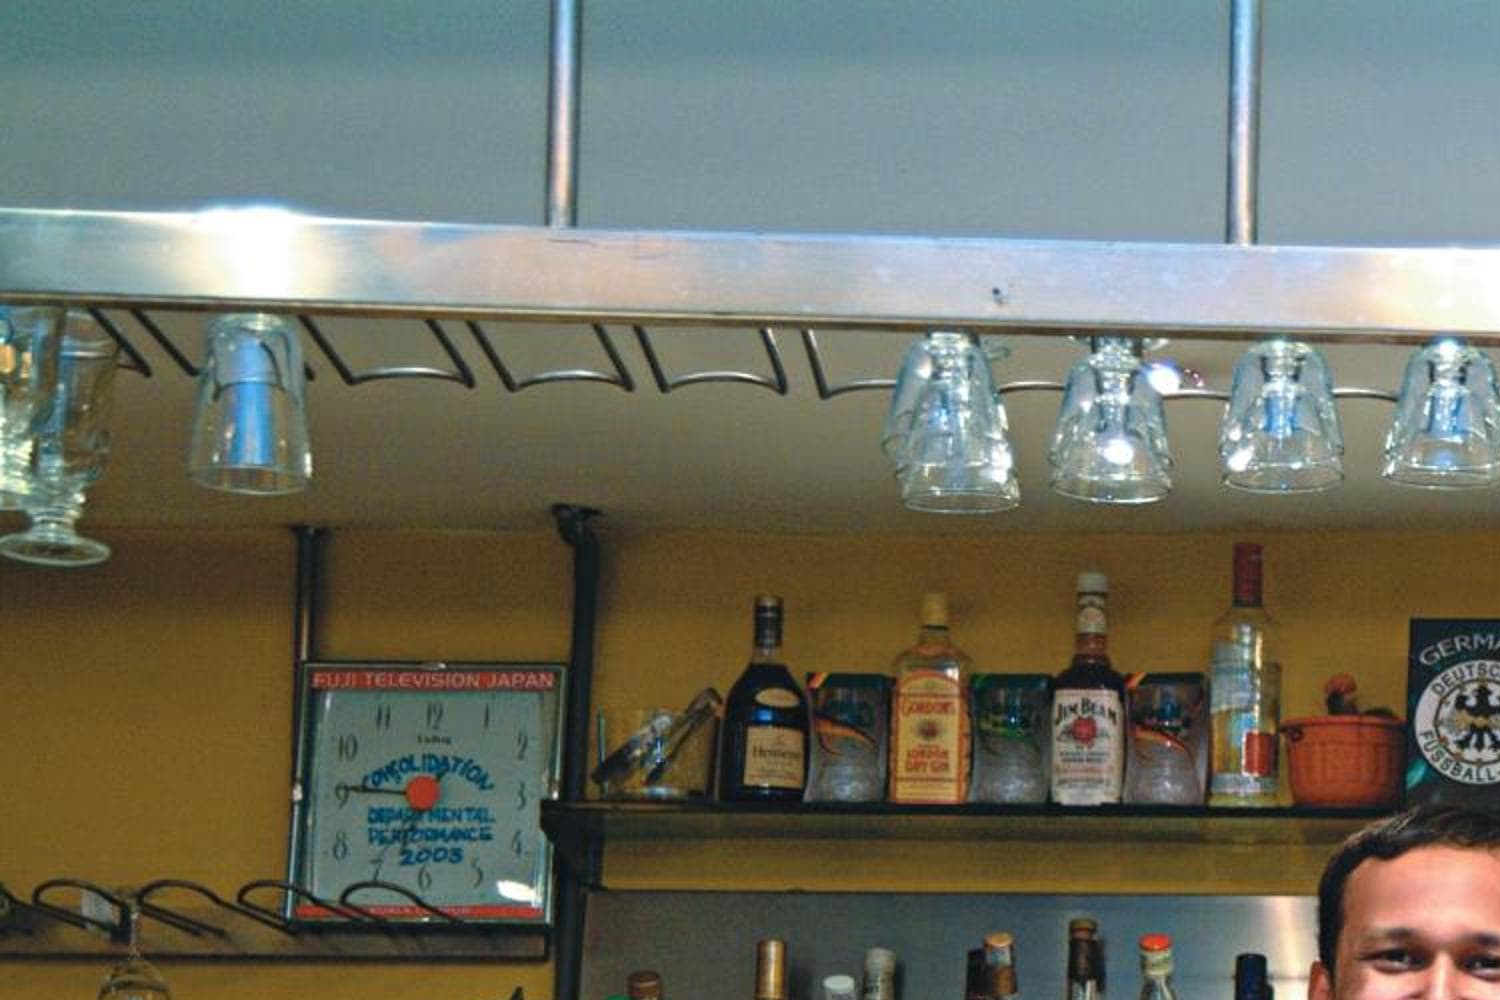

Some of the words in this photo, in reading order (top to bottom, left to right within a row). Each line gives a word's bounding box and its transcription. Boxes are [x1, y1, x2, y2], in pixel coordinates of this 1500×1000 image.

[313, 672, 358, 689] FUJI
[366, 671, 481, 688] TELEVISION
[486, 671, 554, 688] JAPAN
[425, 703, 444, 730] 12
[338, 732, 358, 762] 10
[517, 731, 528, 760] 2
[335, 782, 350, 810] 9
[517, 781, 527, 809] 3
[332, 831, 348, 861] 8
[417, 865, 432, 891] 6
